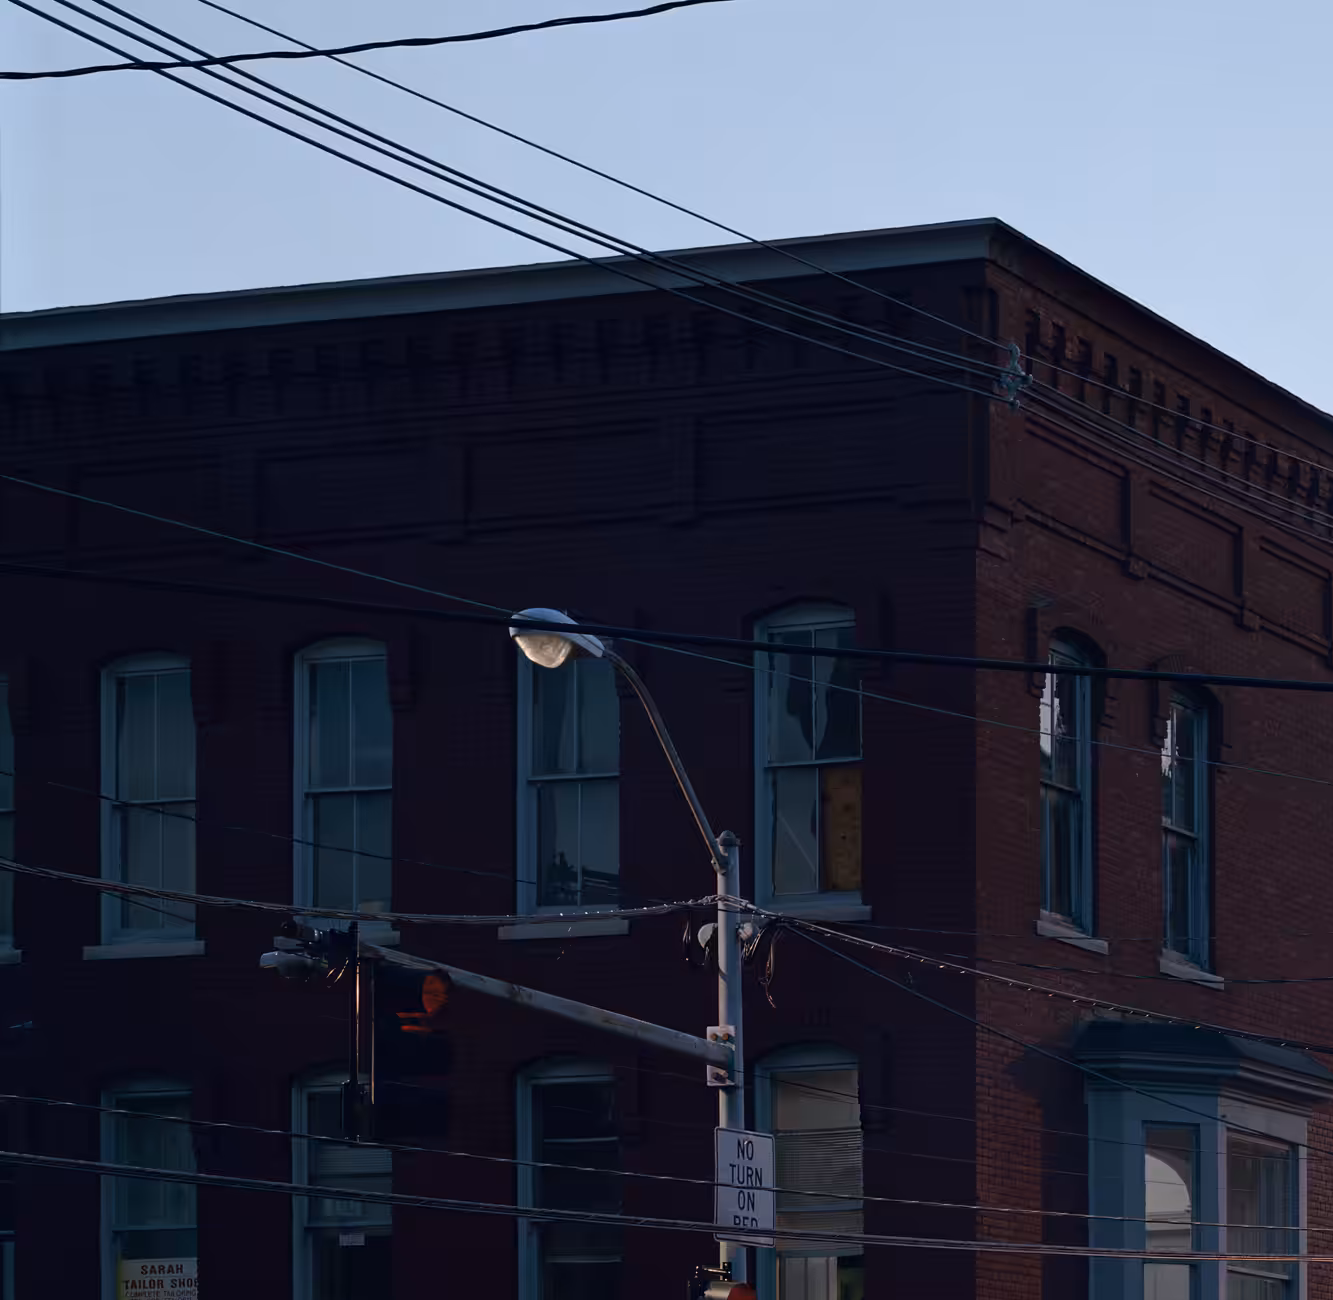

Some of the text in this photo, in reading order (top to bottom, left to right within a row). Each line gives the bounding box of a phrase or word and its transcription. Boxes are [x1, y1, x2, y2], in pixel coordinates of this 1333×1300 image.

[737, 1139, 754, 1161] NO
[729, 1163, 763, 1187] TURN
[737, 1190, 755, 1212] ON
[140, 1264, 184, 1275] SARAH
[125, 1279, 164, 1290] TAILOR
